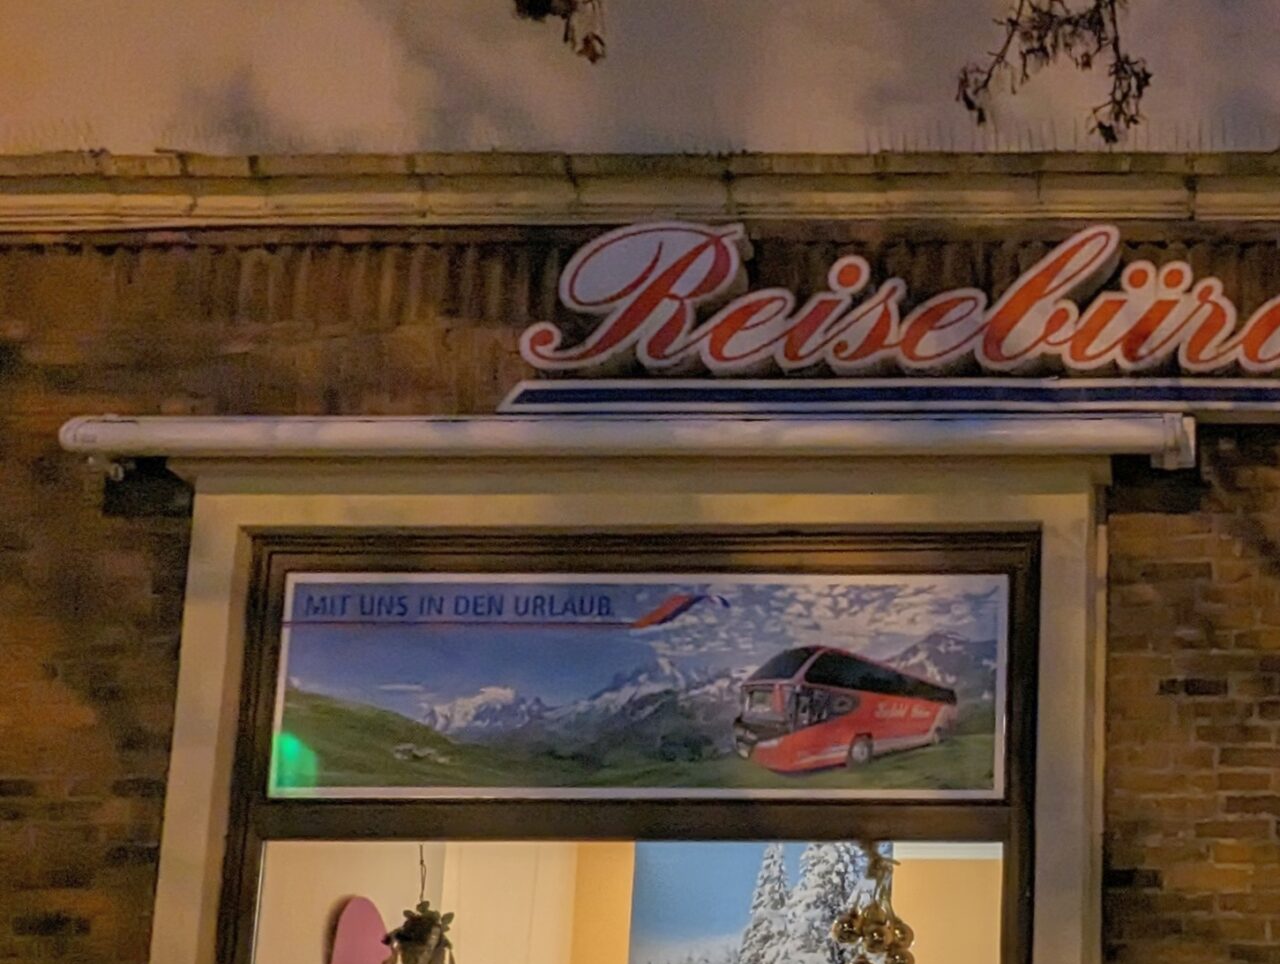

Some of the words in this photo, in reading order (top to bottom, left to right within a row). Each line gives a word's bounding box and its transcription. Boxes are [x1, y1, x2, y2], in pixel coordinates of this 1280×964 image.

[304, 594, 350, 616] MIT
[359, 594, 409, 616] UNS
[419, 595, 444, 616] IN
[453, 594, 504, 616] DEN
